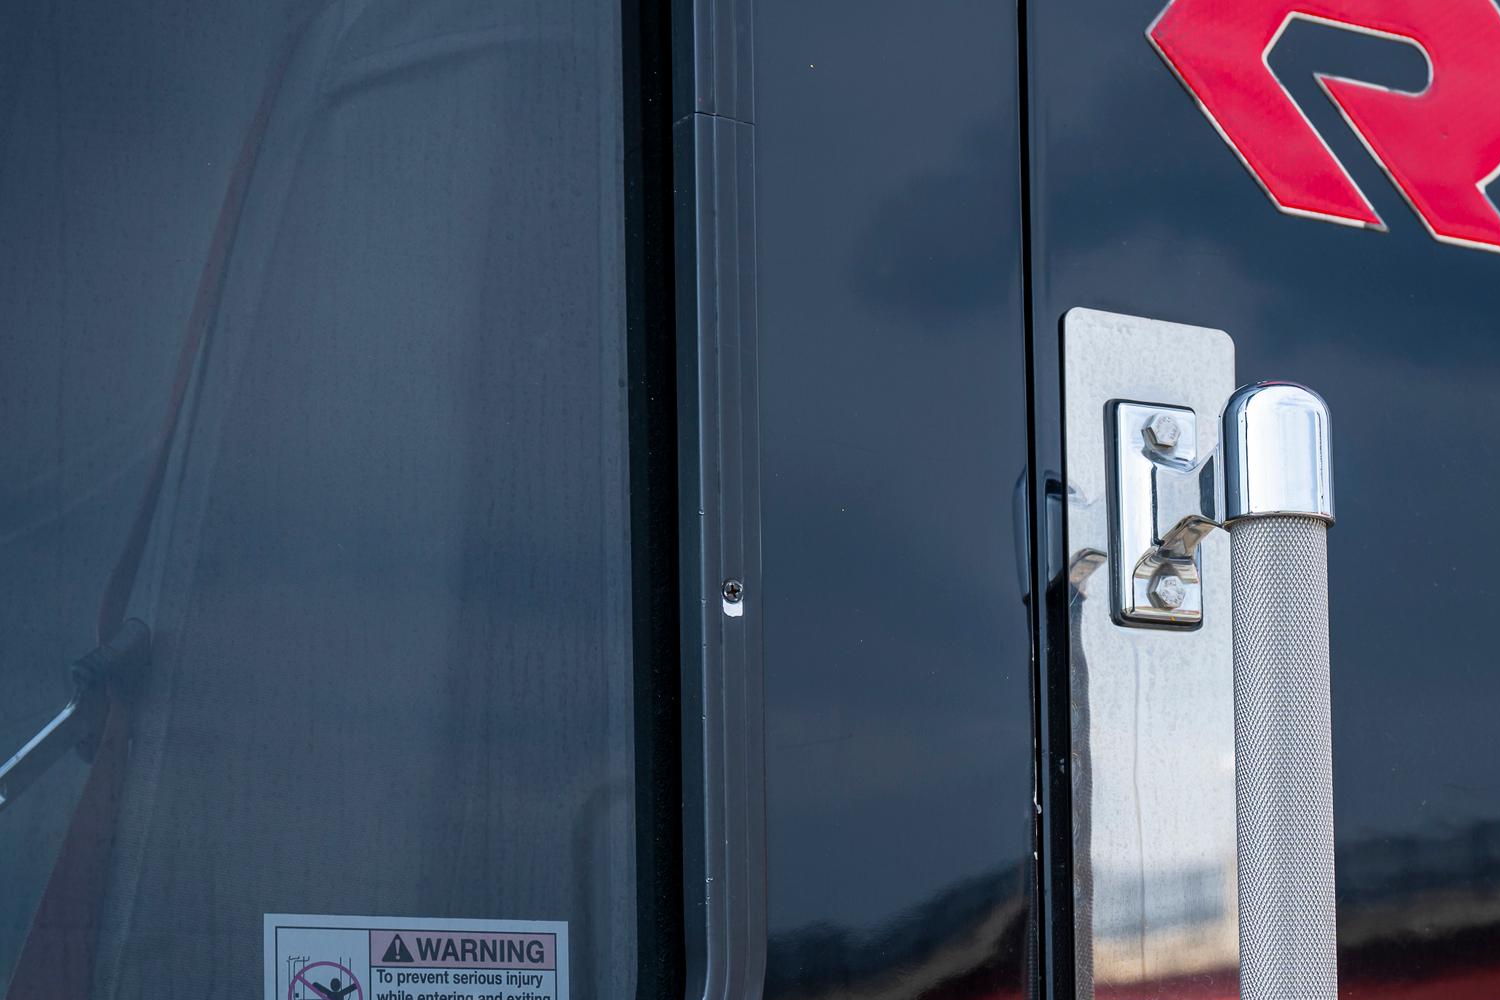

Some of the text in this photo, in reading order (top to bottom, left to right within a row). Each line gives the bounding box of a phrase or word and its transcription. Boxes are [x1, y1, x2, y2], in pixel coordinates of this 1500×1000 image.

[415, 937, 545, 964] WARNING
[376, 969, 543, 989] To prevent serious injury
